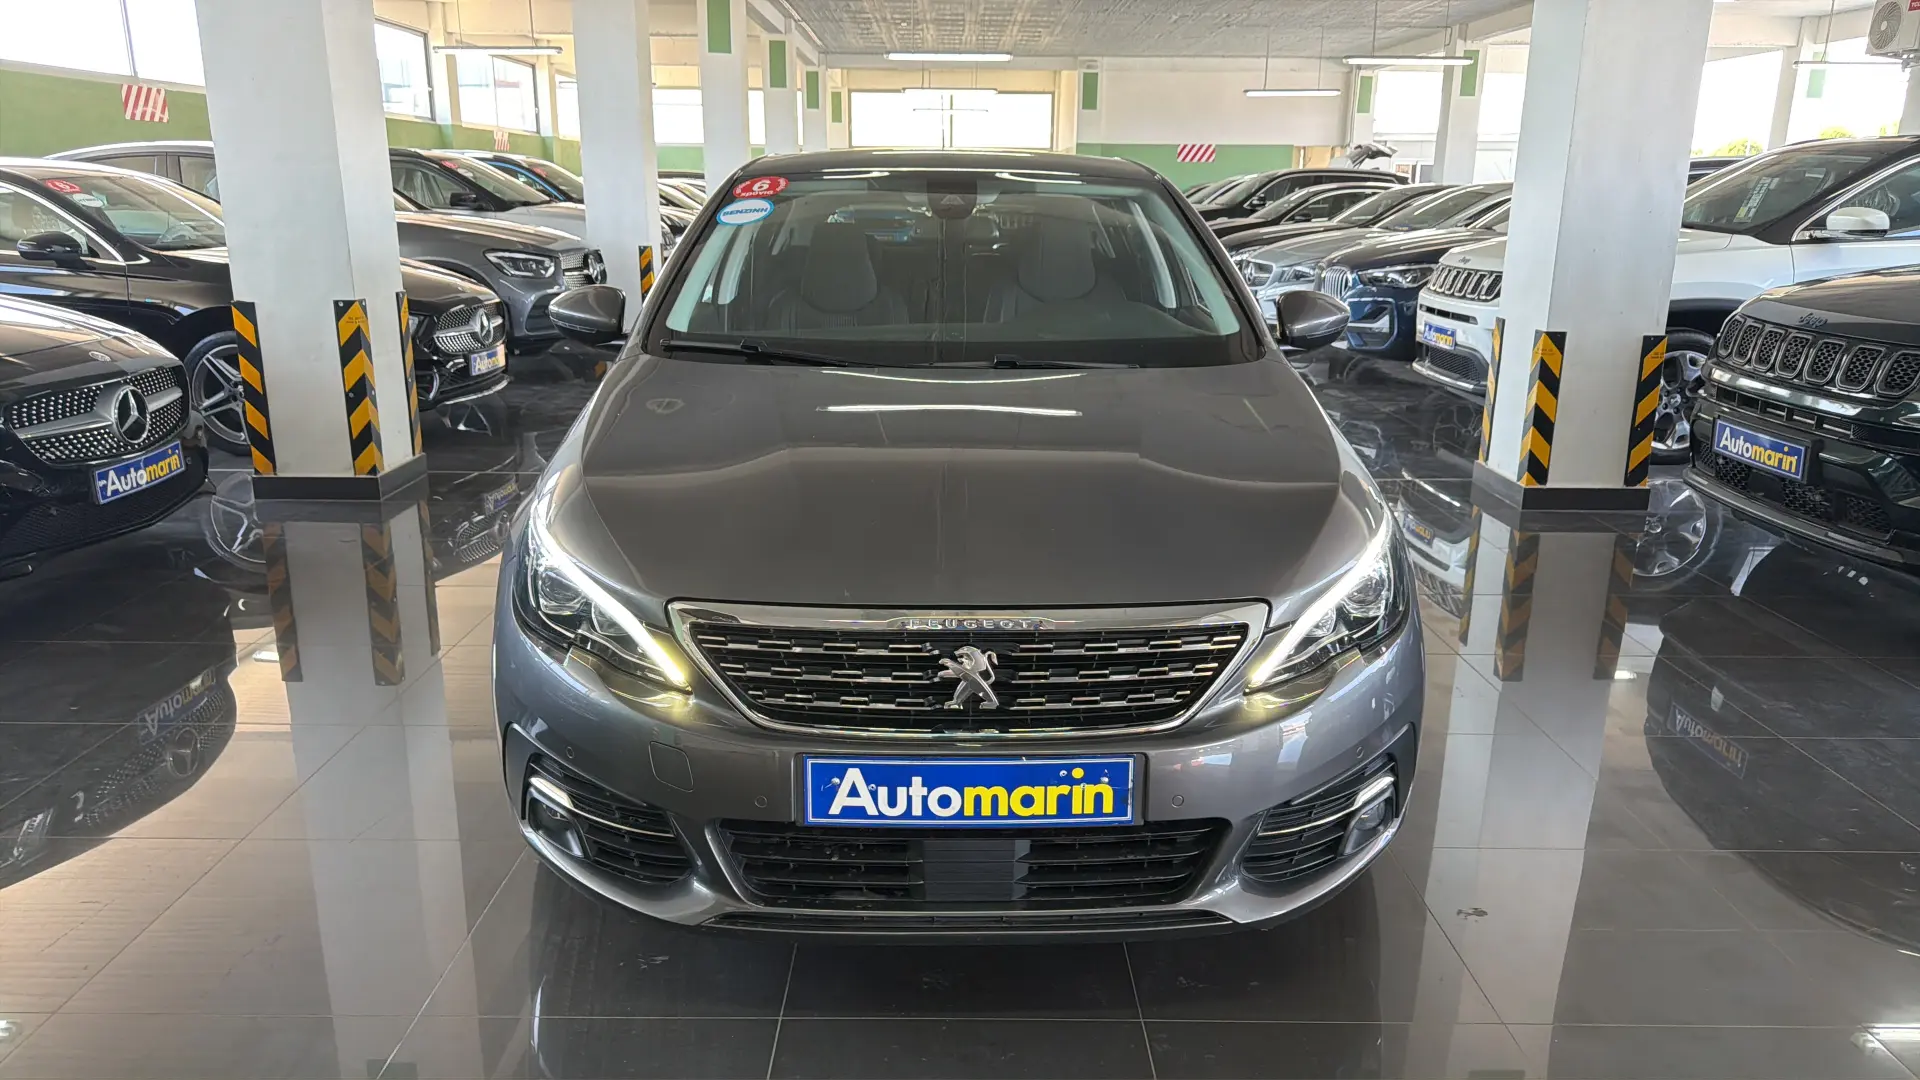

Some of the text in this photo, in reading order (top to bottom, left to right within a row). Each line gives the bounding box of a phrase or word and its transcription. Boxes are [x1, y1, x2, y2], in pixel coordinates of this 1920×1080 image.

[752, 179, 771, 191] 6
[106, 448, 180, 497] Automarin
[1719, 426, 1798, 473] Automarin
[909, 618, 1032, 630] PEUGEOT
[828, 767, 1114, 817] Automarin
